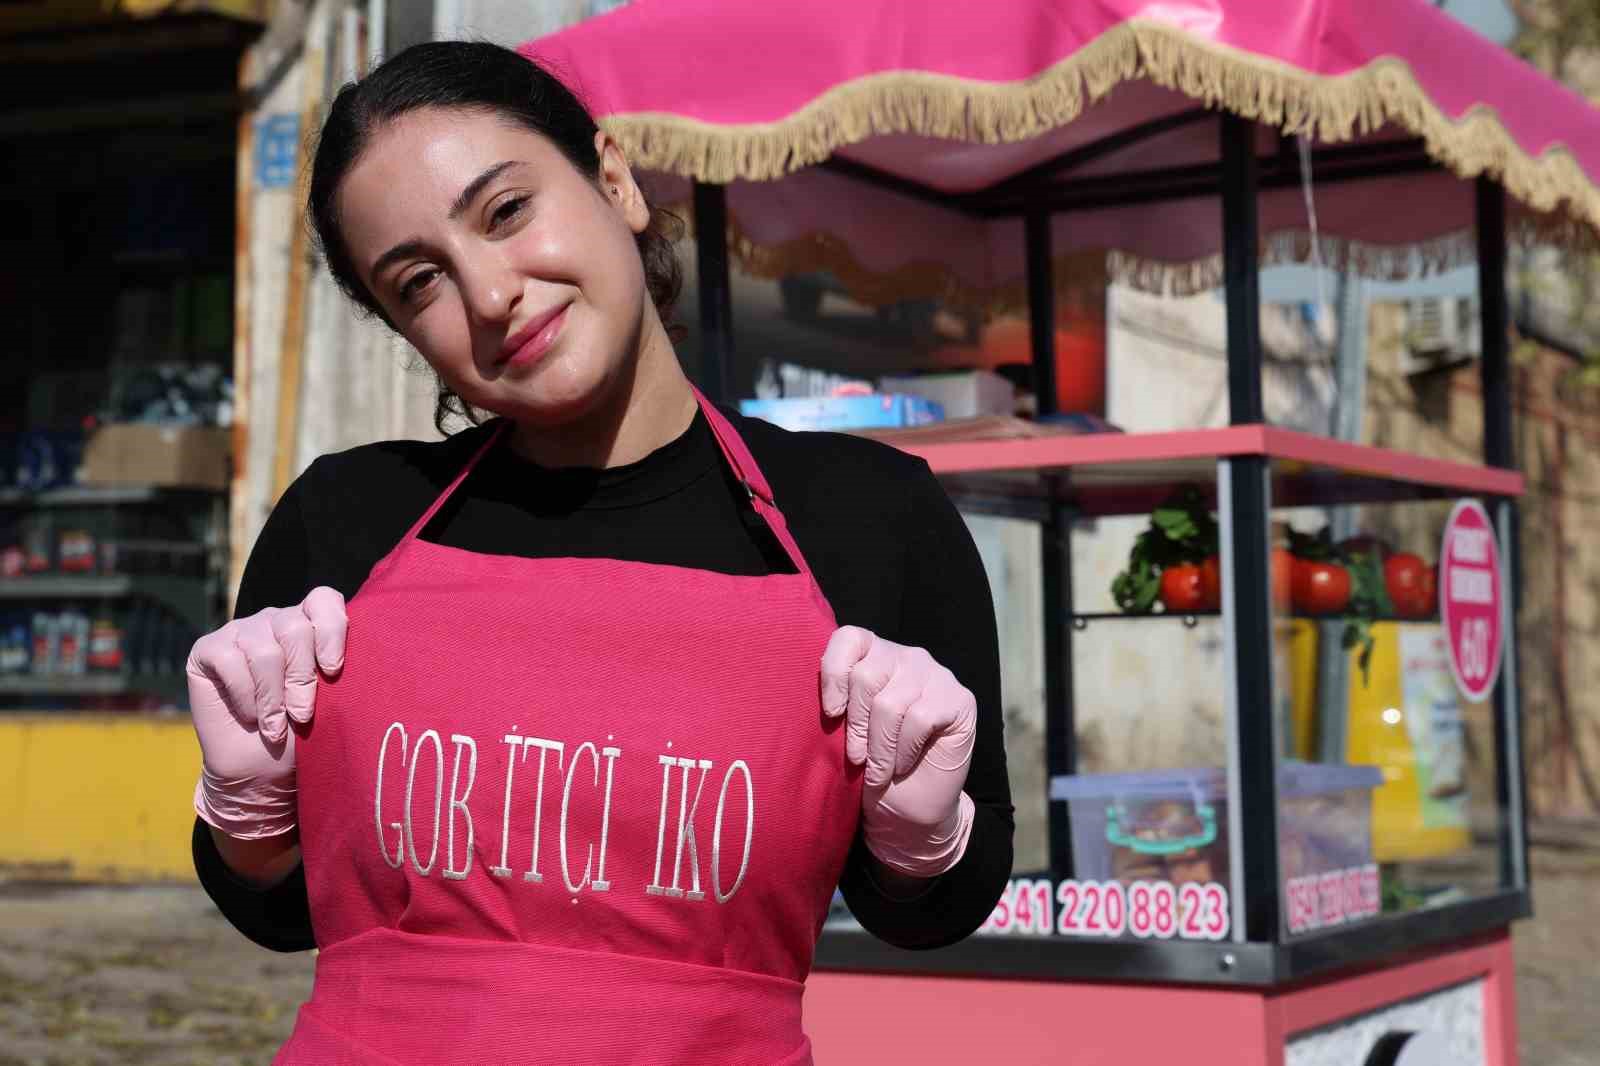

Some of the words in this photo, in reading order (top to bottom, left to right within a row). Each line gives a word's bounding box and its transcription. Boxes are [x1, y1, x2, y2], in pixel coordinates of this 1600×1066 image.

[646, 741, 755, 904] İKO
[980, 885, 1050, 929] 541
[1060, 885, 1123, 930] 220
[1133, 886, 1172, 933] 88
[1182, 887, 1225, 934] 23
